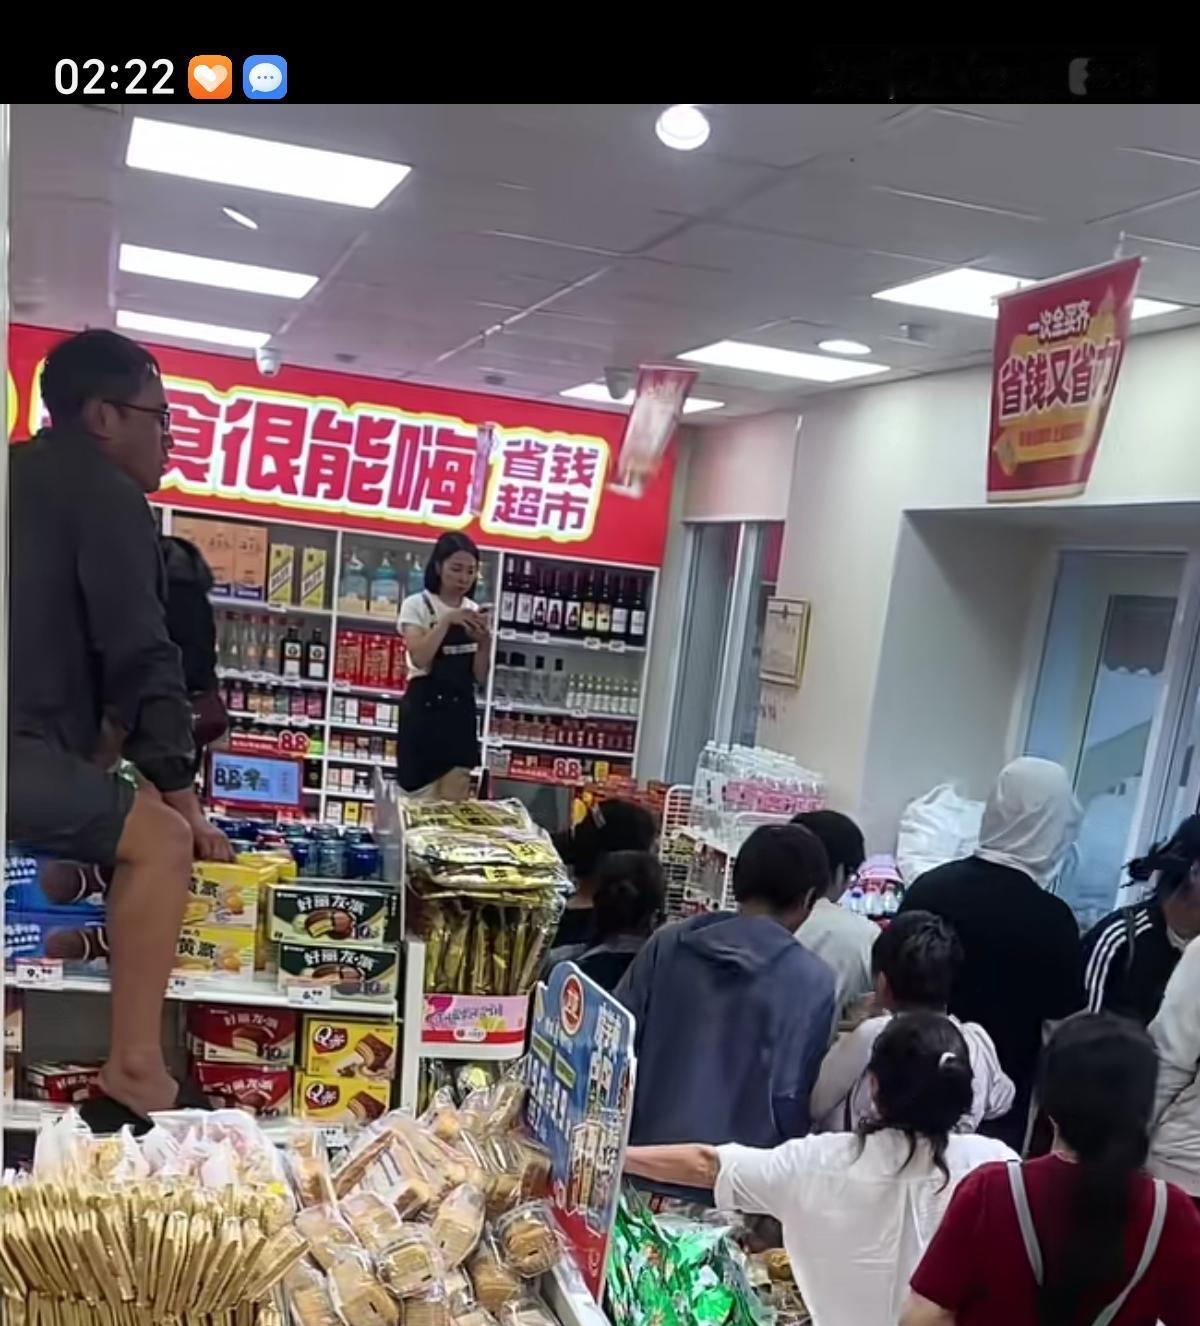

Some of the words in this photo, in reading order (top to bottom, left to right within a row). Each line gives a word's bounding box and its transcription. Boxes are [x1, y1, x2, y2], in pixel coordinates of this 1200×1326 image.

[1001, 338, 1122, 416] 省钱又省力
[40, 388, 477, 517] 食很能嗨
[502, 439, 599, 489] 省钱
[491, 483, 589, 531] 超市
